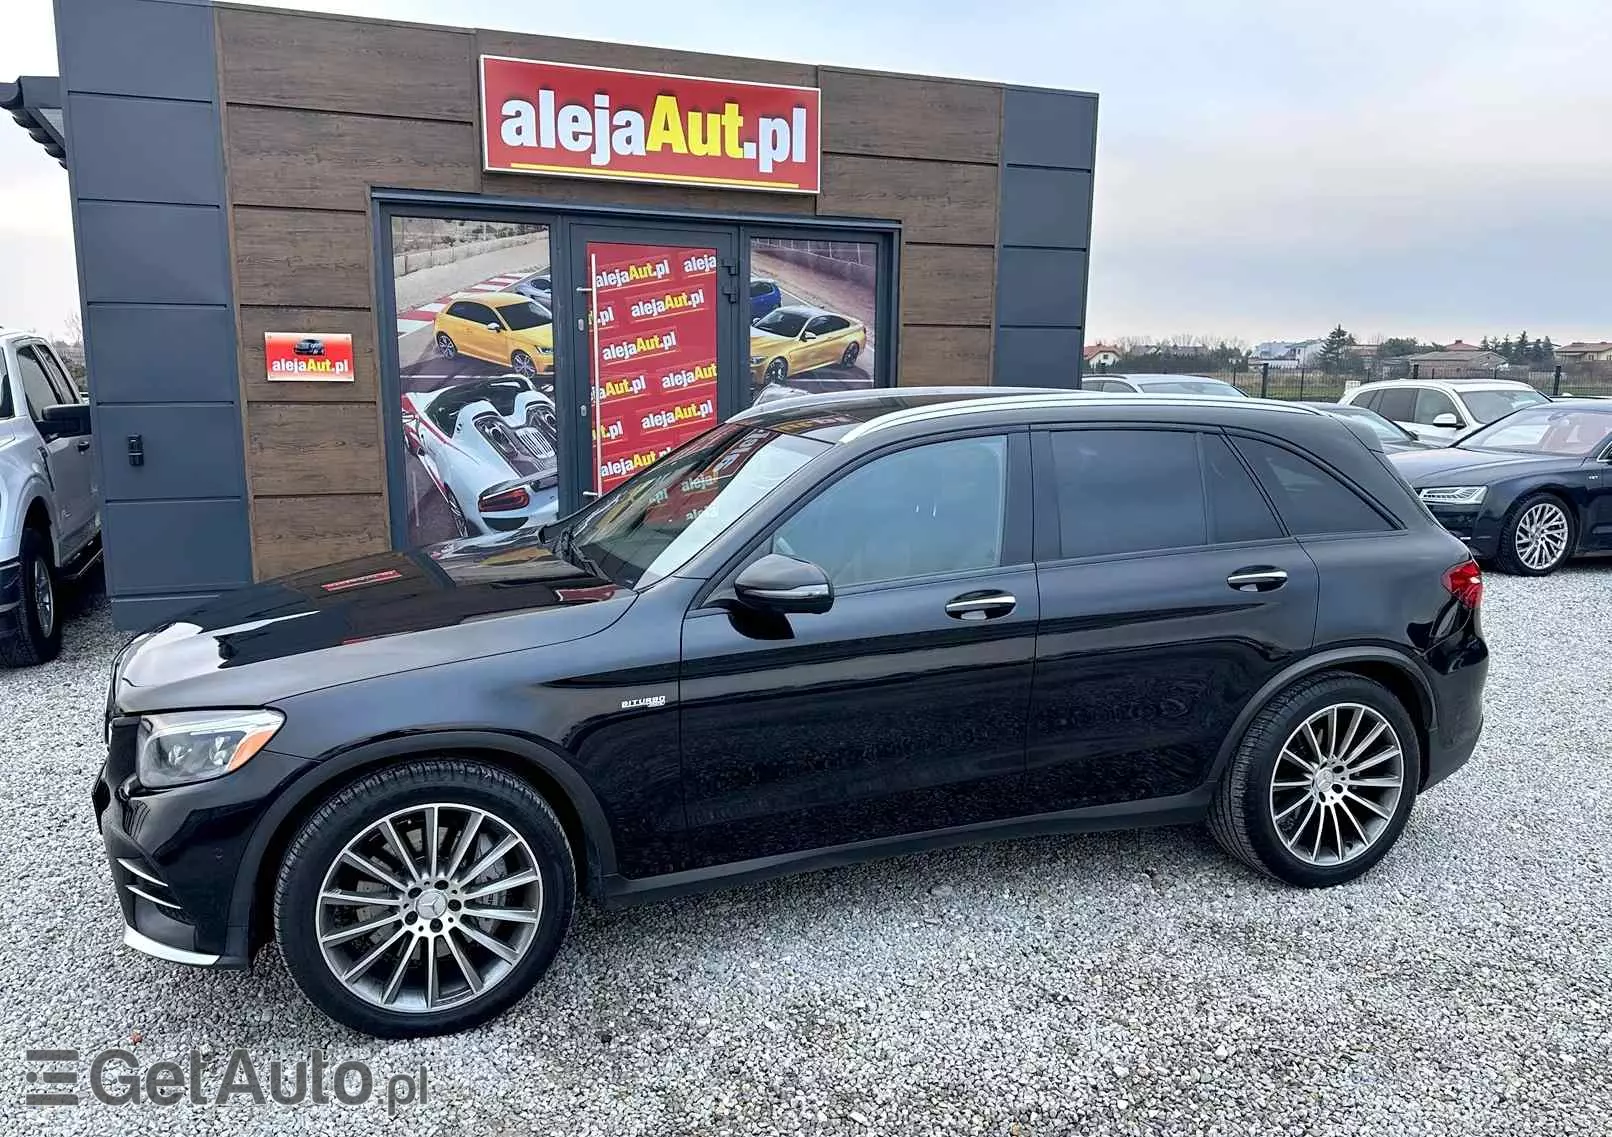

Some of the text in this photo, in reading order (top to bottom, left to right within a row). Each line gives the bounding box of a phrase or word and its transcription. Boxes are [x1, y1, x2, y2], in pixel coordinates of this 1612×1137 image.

[501, 89, 806, 173] alejaAut.pl
[596, 259, 670, 287] alejaAut.pl
[631, 289, 704, 316] alejaAut.pl
[602, 331, 676, 360] alejaAut.pl
[272, 358, 348, 374] alejaAut.pl
[661, 363, 717, 388] alejaAut
[641, 400, 713, 429] alejaAut.pl
